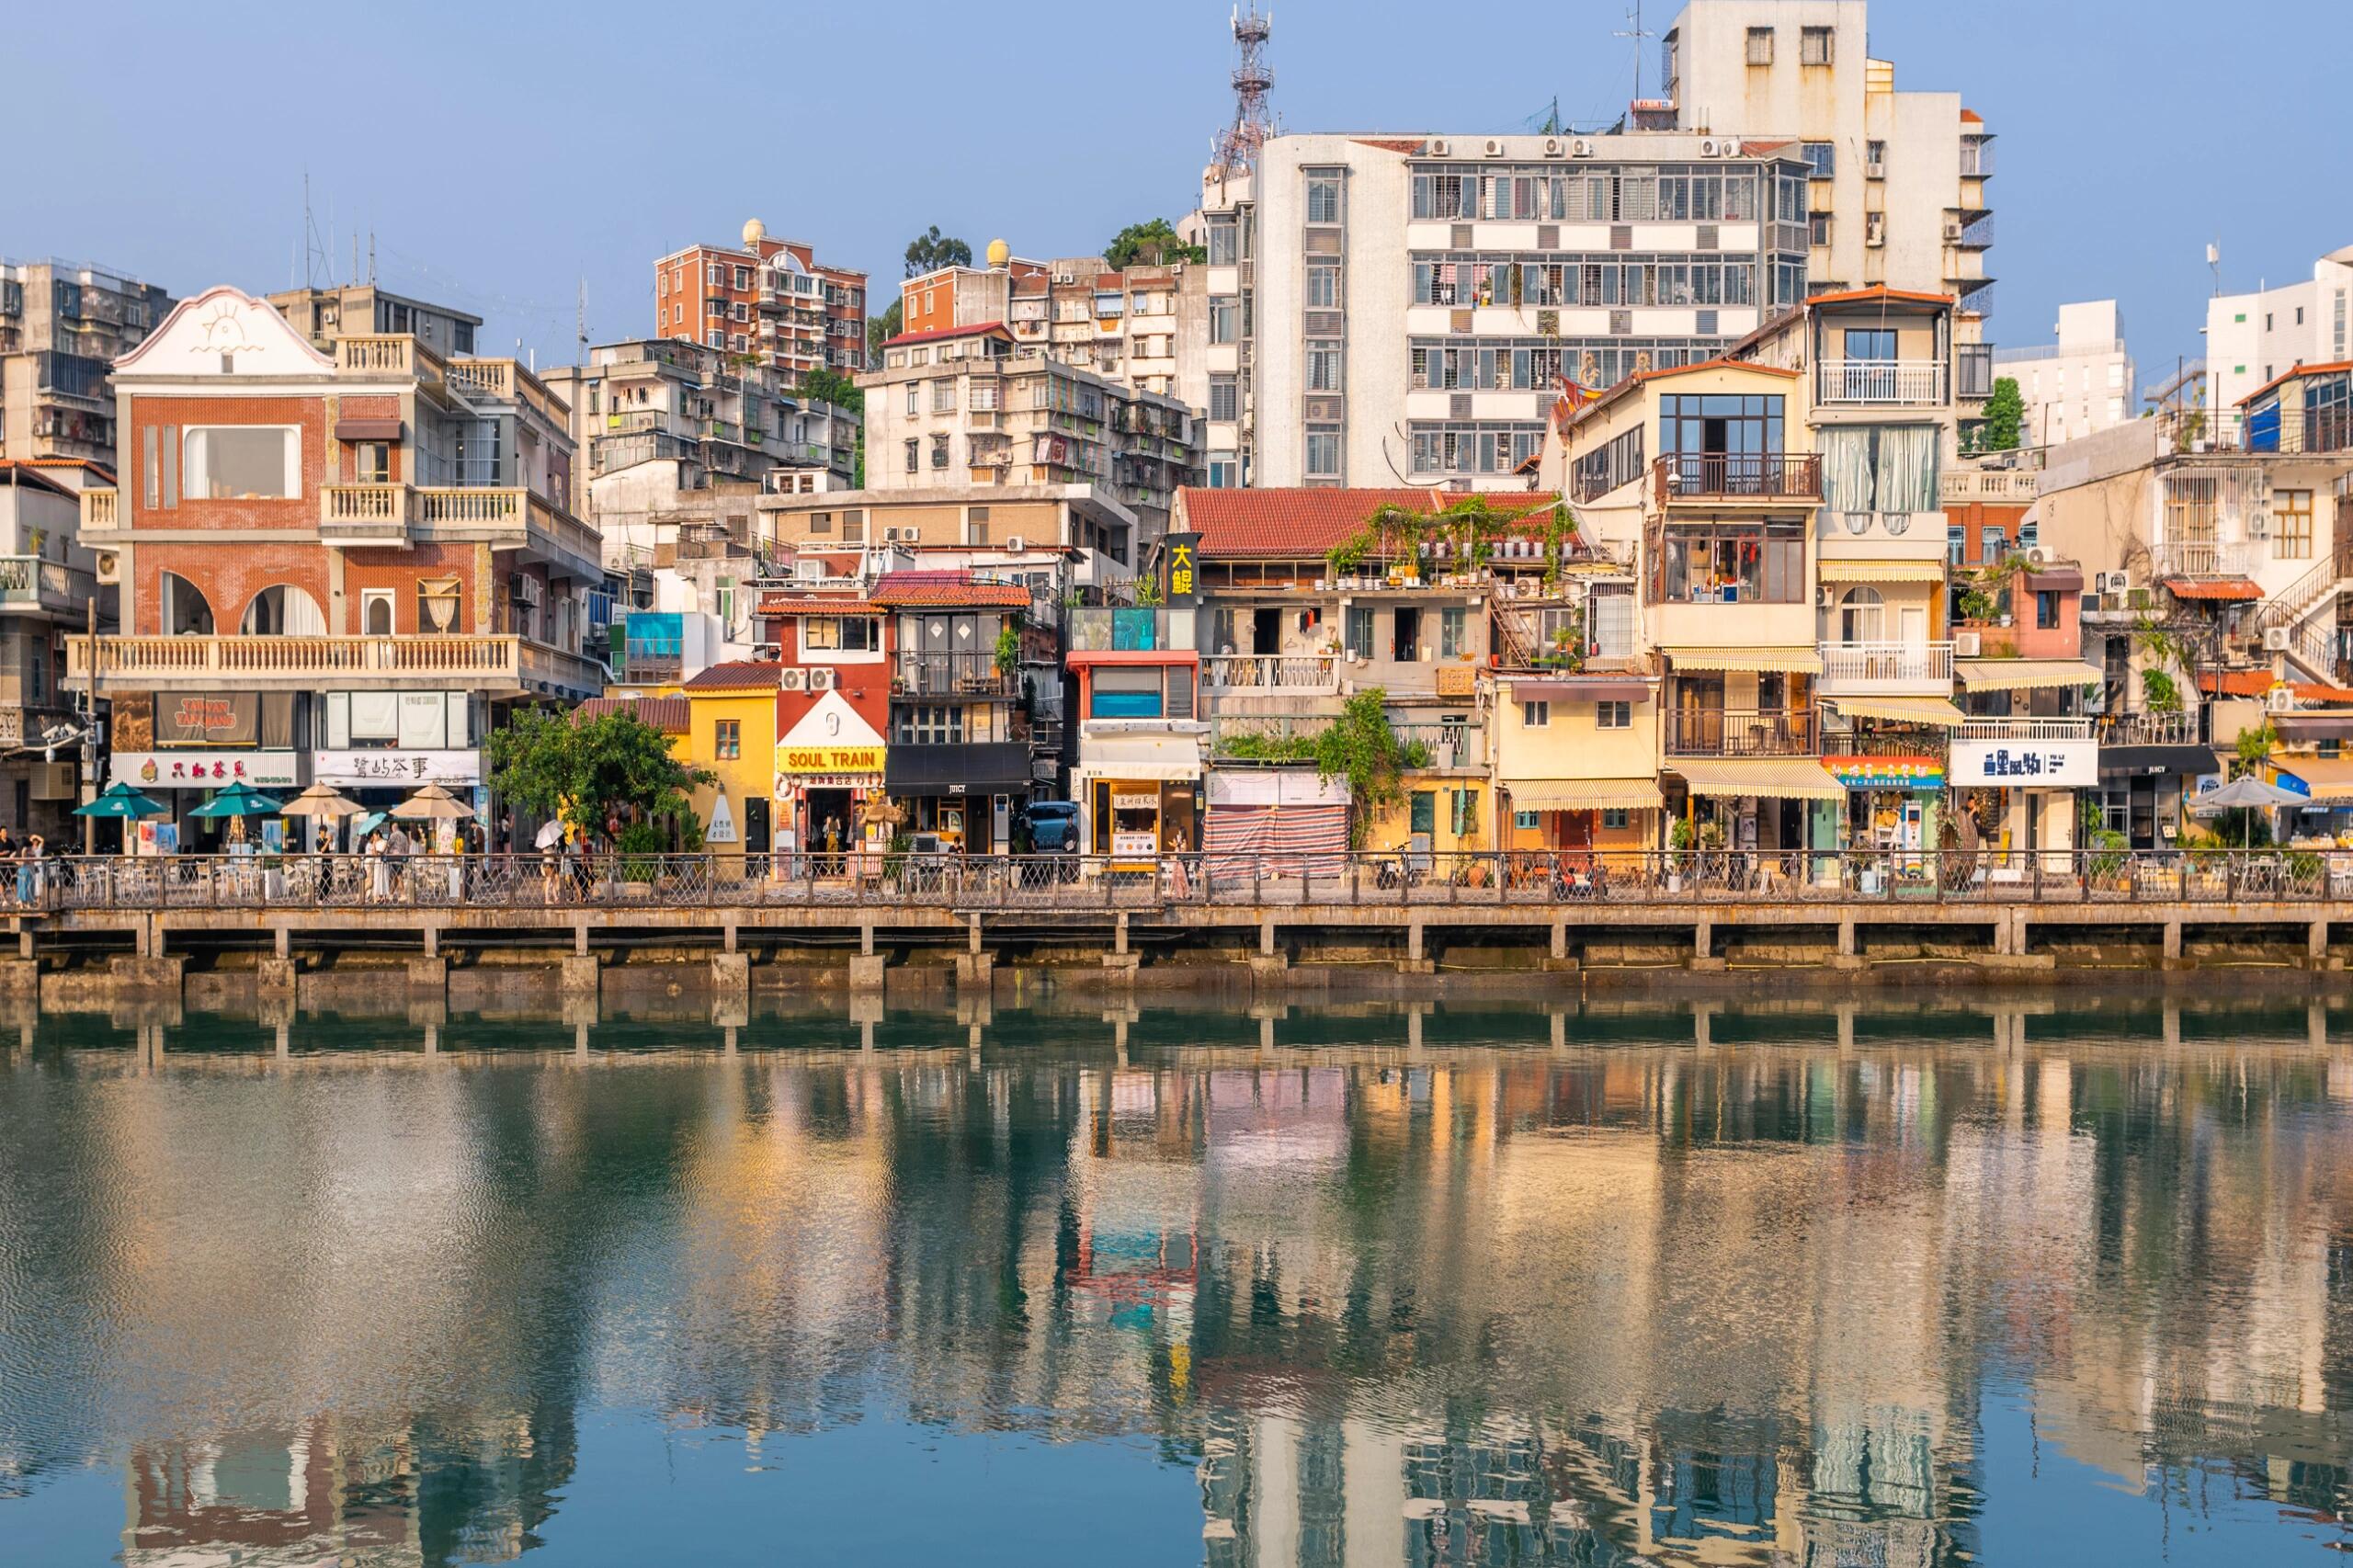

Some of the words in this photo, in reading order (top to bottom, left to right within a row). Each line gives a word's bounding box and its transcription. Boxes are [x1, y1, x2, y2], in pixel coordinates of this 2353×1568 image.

[789, 752, 826, 768] SOUL
[830, 752, 875, 768] TRAIN
[2148, 766, 2166, 775] JUICY
[949, 784, 966, 795] JUICY
